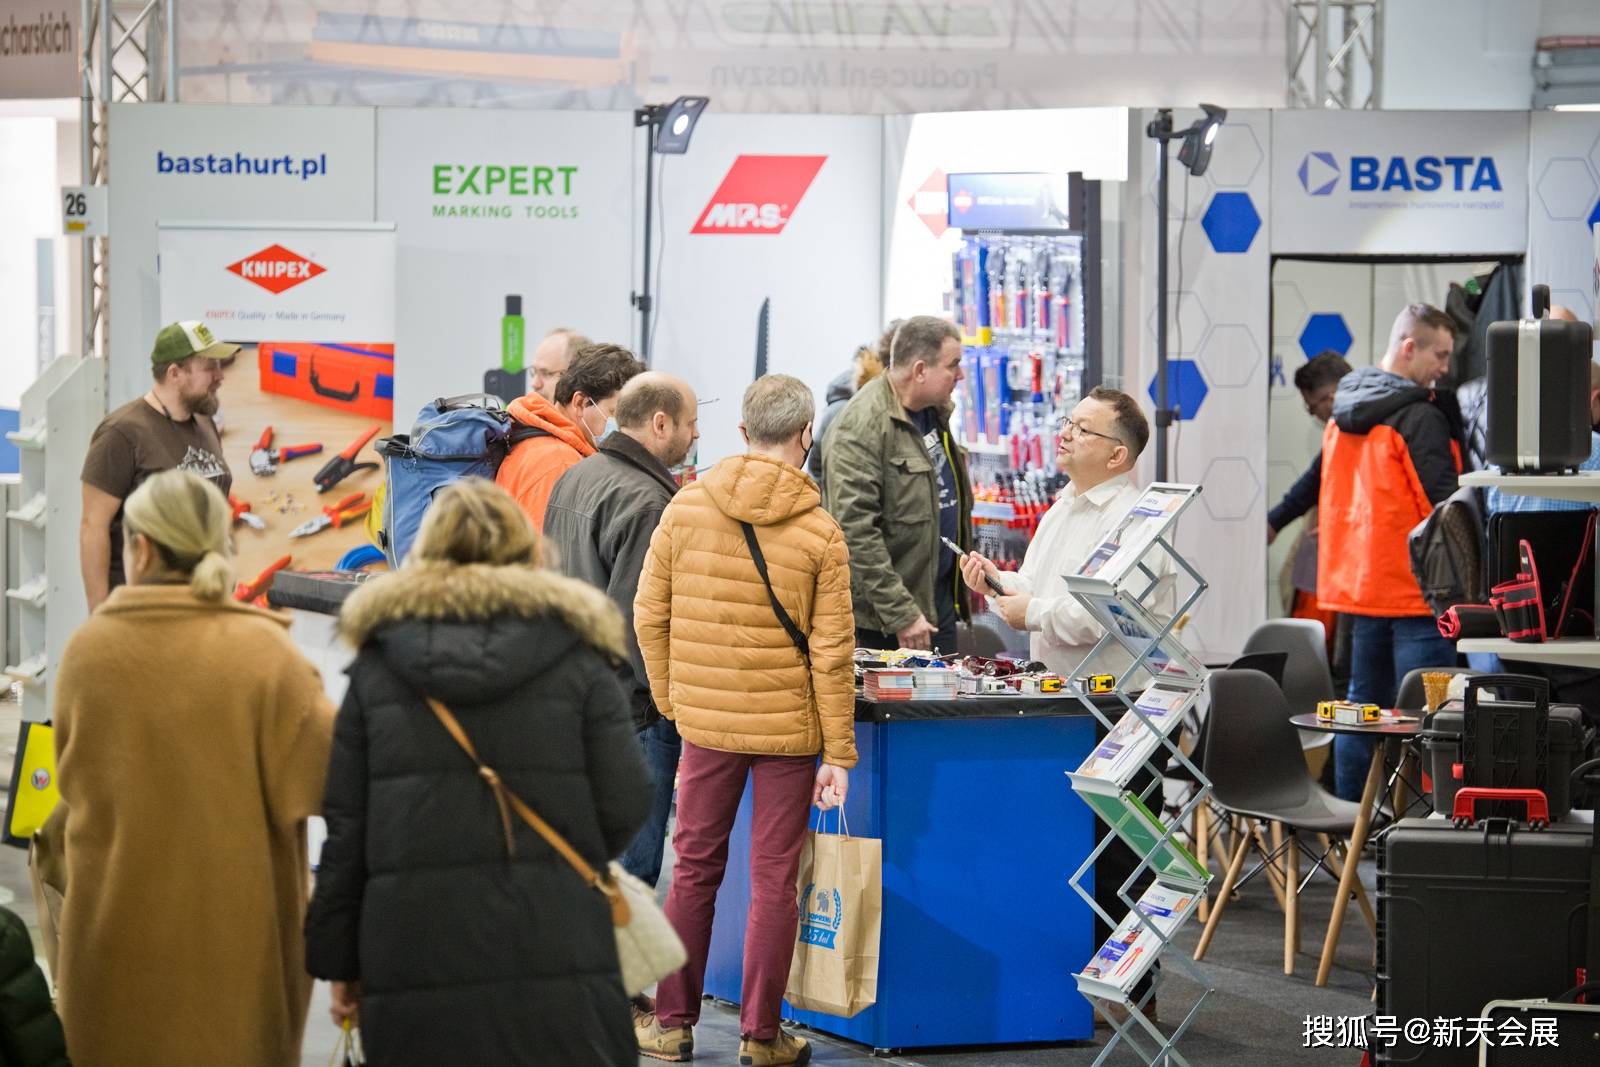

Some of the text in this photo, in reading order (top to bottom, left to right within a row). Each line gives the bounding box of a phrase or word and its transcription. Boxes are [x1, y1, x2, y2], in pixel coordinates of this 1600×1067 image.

[157, 150, 327, 181] bastahurt.pl
[1350, 156, 1503, 191] BASTA
[432, 164, 579, 196] EXPERT
[65, 191, 87, 216] 26
[432, 205, 579, 218] MARKING TOOLS
[241, 260, 311, 279] KNIPEX
